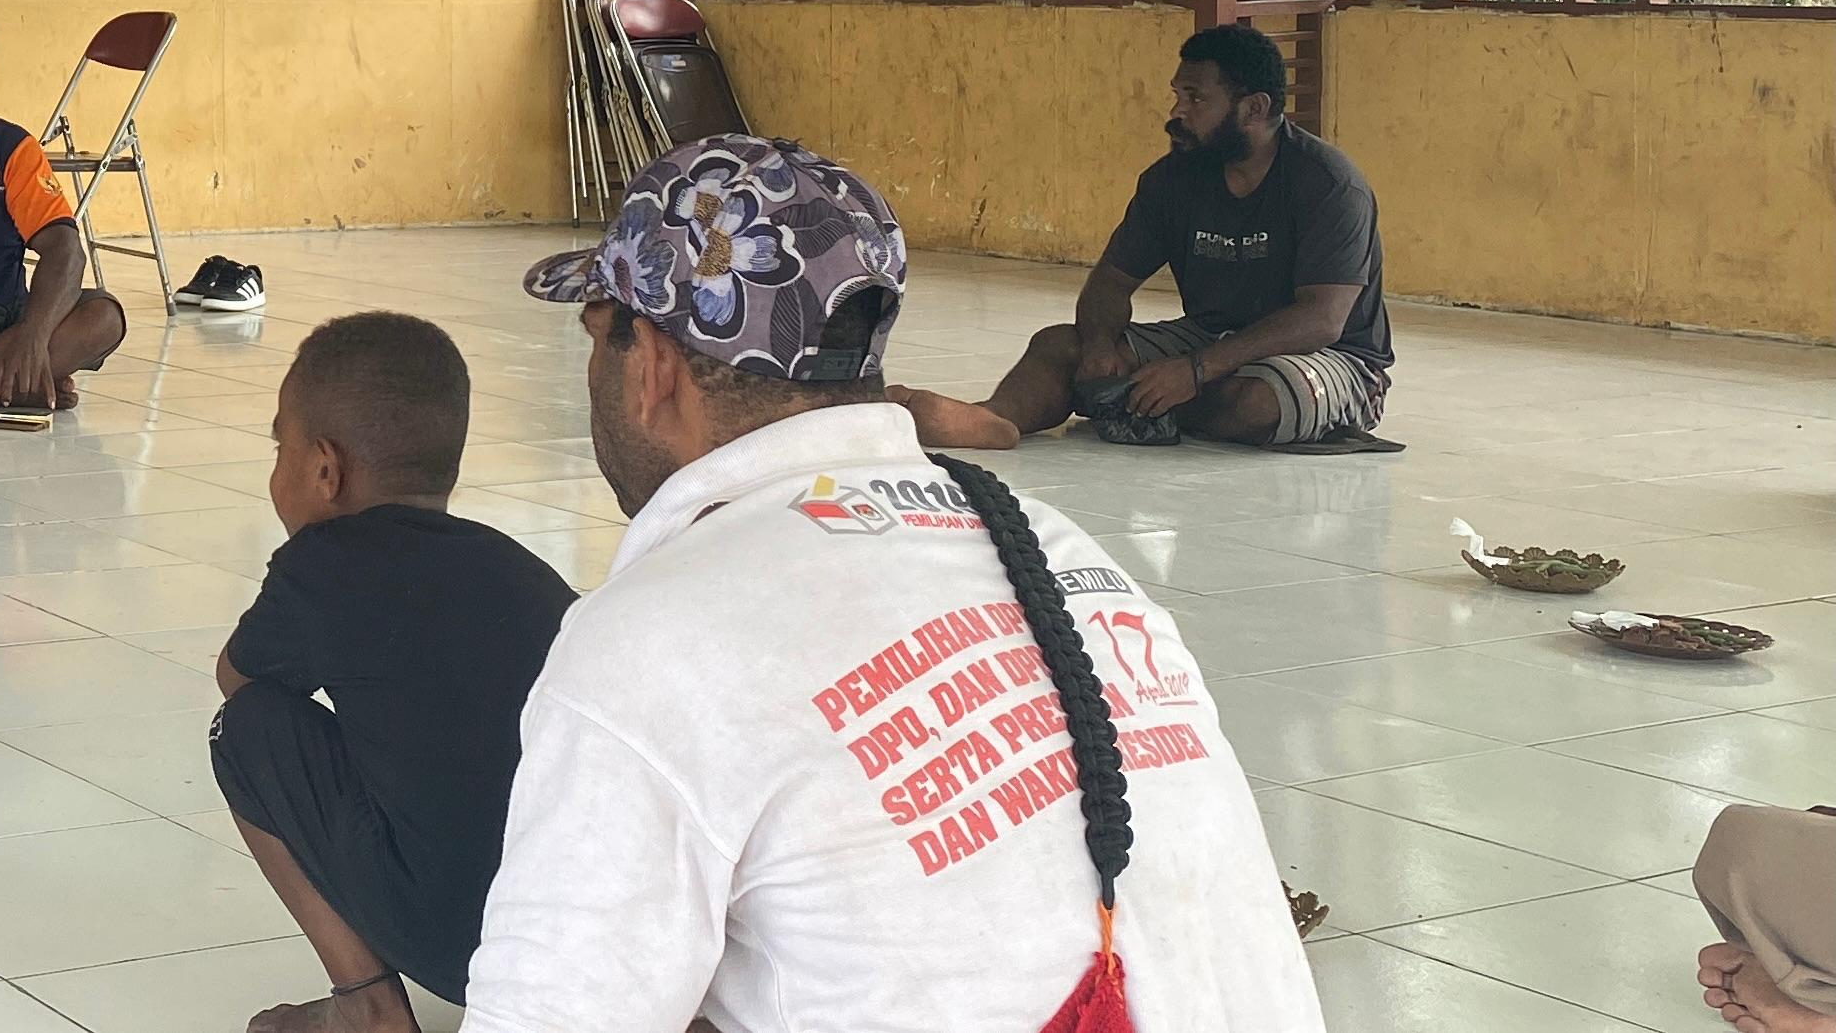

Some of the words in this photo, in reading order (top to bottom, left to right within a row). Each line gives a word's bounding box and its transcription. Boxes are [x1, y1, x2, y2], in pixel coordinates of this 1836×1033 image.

[900, 513, 965, 529] PEMILIHAN
[1057, 568, 1127, 593] EMILU
[812, 606, 998, 733] PEMILIHAN
[1087, 610, 1159, 682] 17
[927, 658, 1008, 728] DAN
[880, 730, 1005, 826] SERTA
[906, 799, 999, 877] DAN
